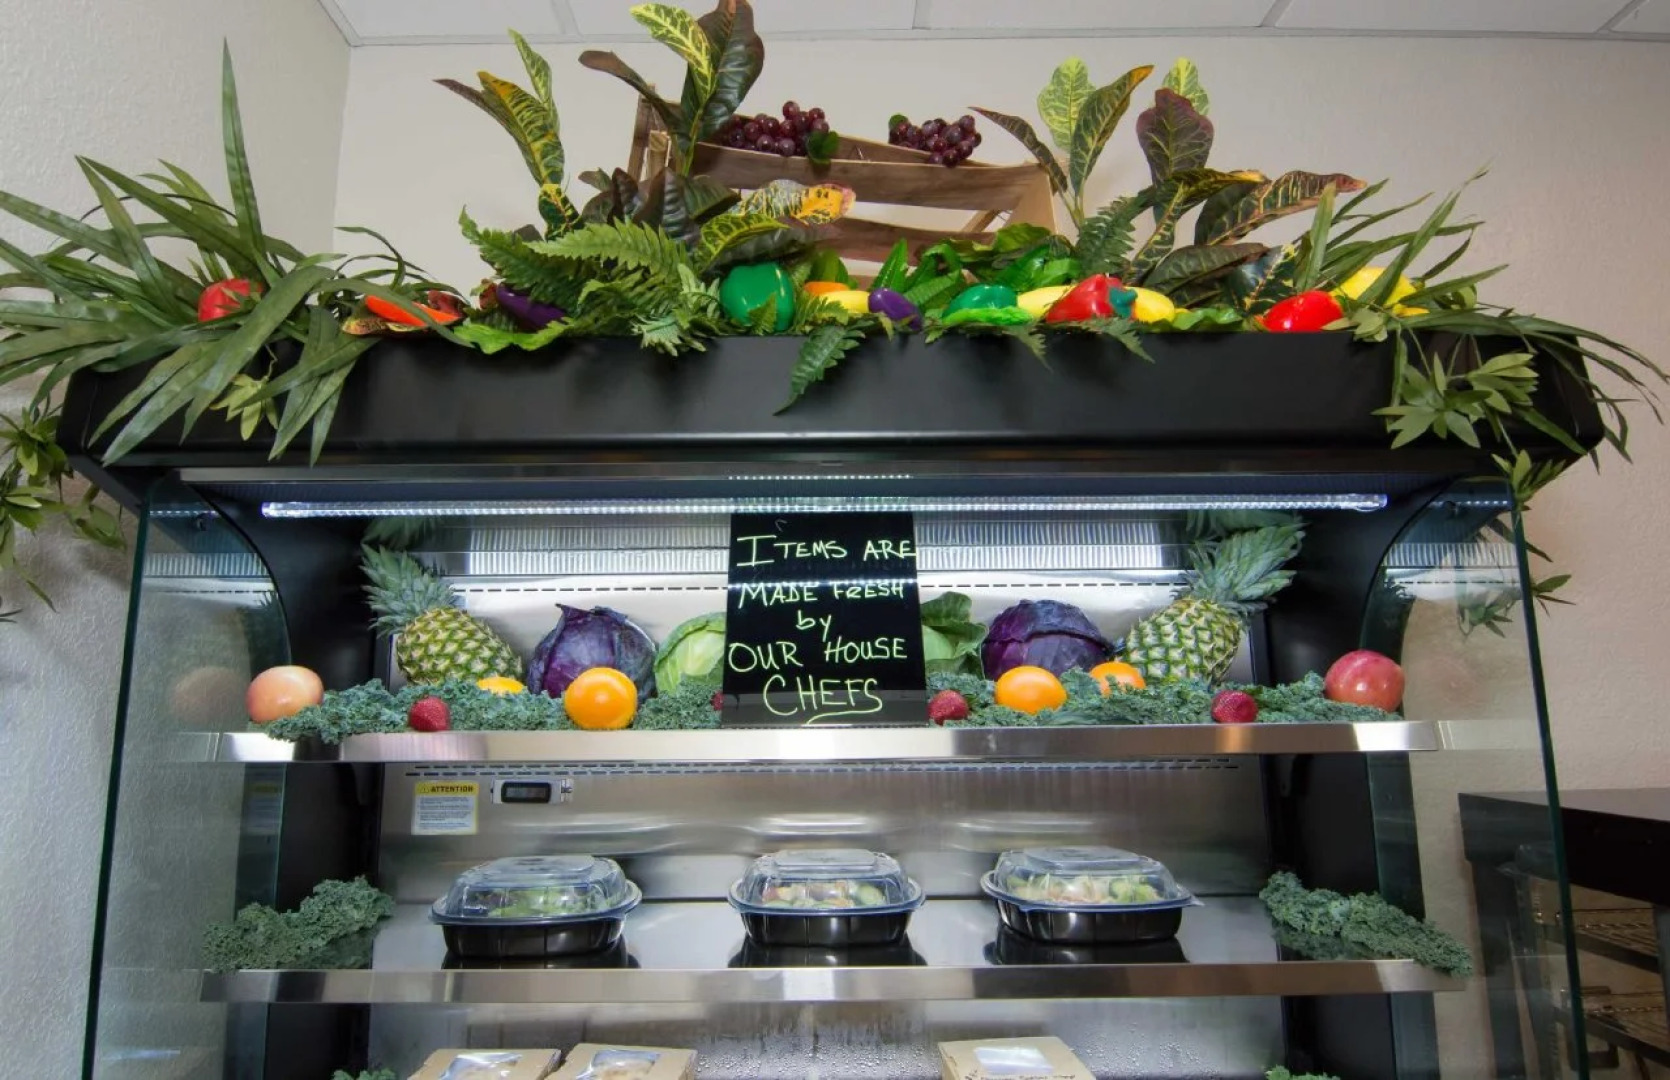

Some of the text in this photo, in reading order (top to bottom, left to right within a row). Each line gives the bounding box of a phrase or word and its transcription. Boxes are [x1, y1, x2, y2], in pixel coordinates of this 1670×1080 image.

[737, 535, 917, 566] ITEMS ARE
[738, 582, 904, 609] MADE FRESH
[796, 609, 832, 642] by
[728, 636, 907, 672] OUR HOUSE
[763, 674, 883, 716] CHEFS
[430, 785, 473, 793] ATTENTION
